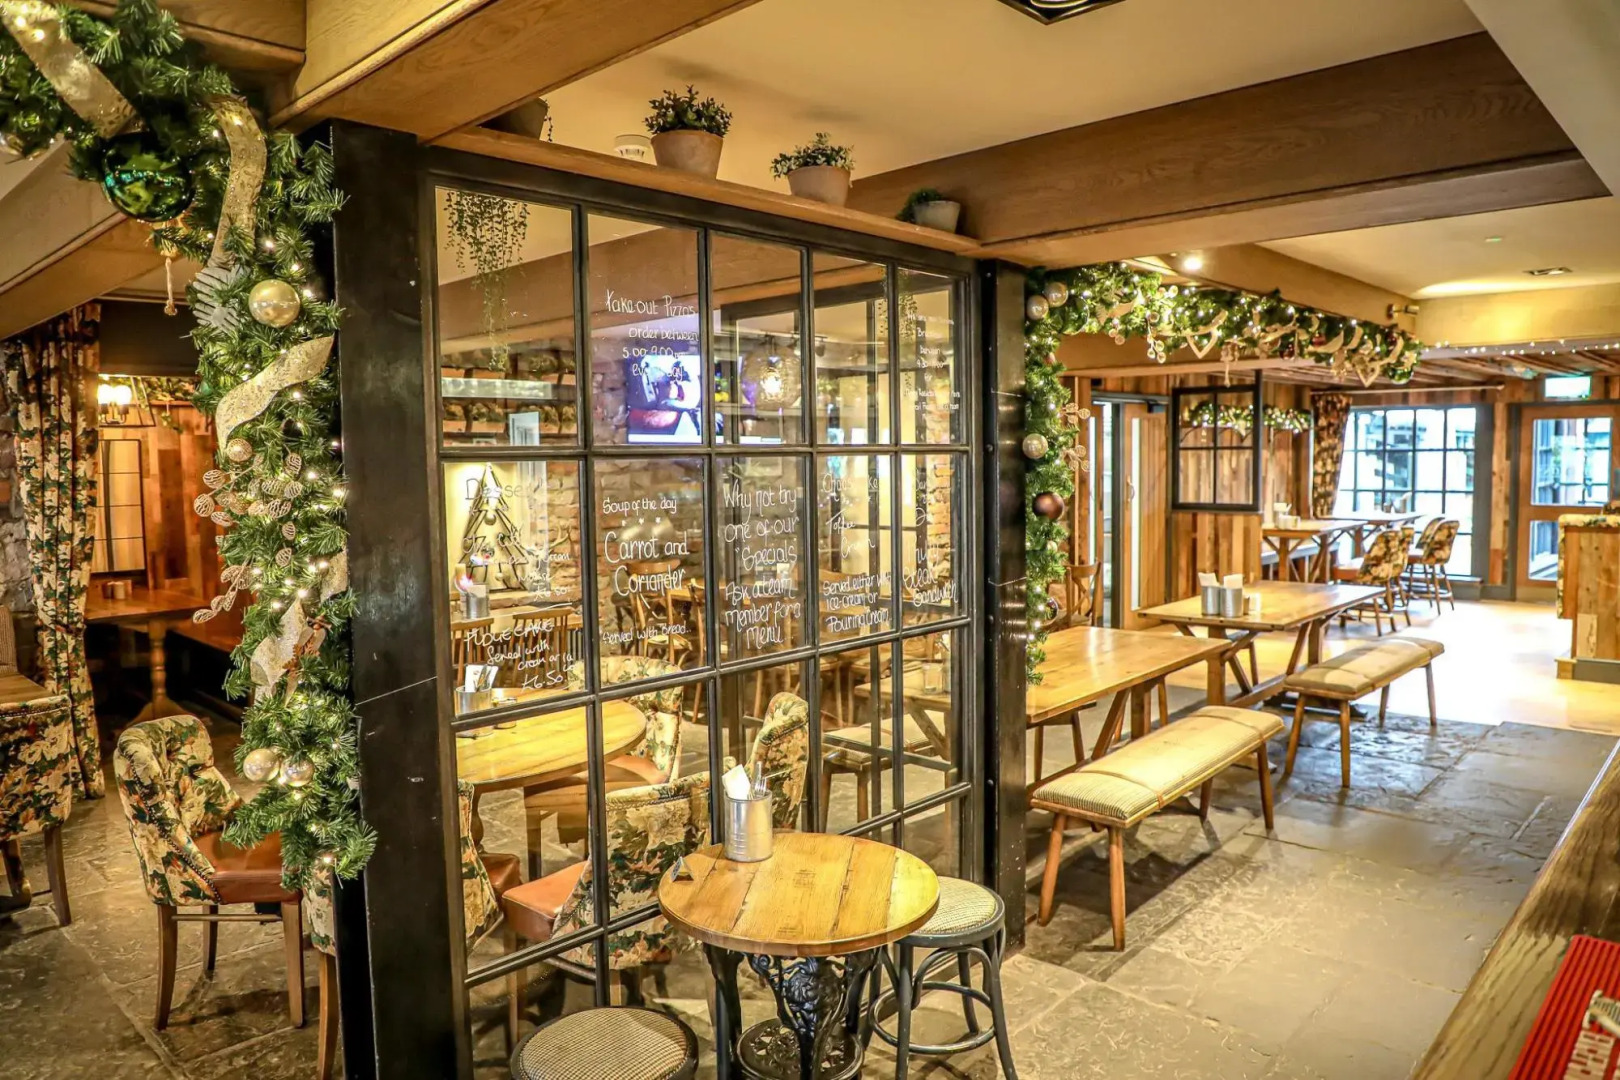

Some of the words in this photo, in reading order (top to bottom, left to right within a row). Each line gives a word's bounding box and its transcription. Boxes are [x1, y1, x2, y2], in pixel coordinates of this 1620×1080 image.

[602, 497, 631, 516] Soup
[631, 499, 642, 516] of
[642, 497, 658, 510] the
[660, 497, 678, 514] day
[723, 479, 752, 526] Why
[755, 486, 776, 518] not
[778, 484, 797, 514] try
[724, 520, 752, 543] one
[756, 518, 770, 547] of
[773, 516, 800, 534] our
[604, 531, 660, 564] Carrot
[664, 531, 690, 556] and
[614, 564, 687, 596] Coriander
[725, 581, 751, 606] Ask
[762, 575, 796, 599] team
[823, 576, 850, 596] Served
[914, 578, 959, 607] Sandwich
[868, 591, 878, 604] or
[513, 618, 555, 638] CAKE
[724, 602, 773, 632] member
[774, 600, 793, 628] for
[525, 638, 550, 655] with
[637, 625, 658, 641] with
[520, 669, 565, 694] £6.50
